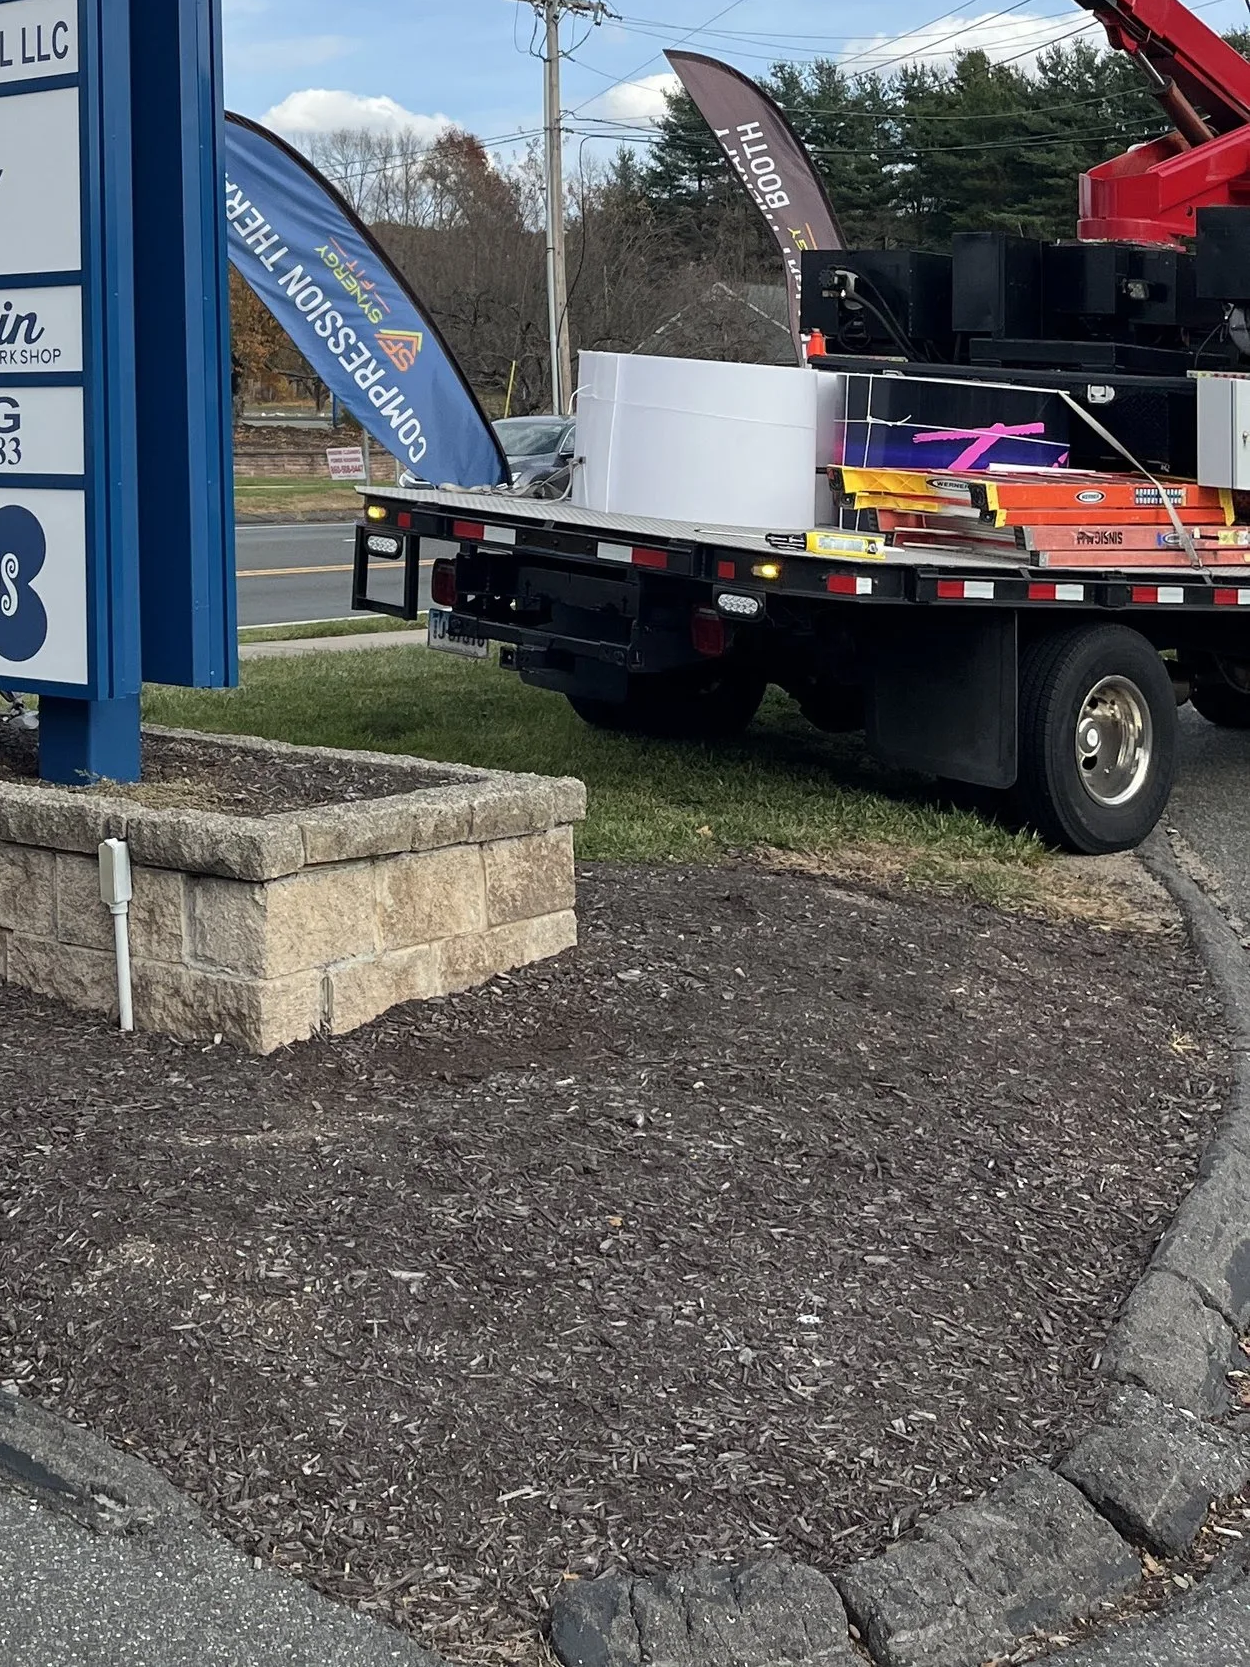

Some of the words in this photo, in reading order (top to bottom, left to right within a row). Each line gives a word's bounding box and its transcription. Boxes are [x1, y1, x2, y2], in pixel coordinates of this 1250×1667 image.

[20, 20, 69, 63] LLC
[736, 120, 791, 210] BOOTH
[313, 244, 384, 325] SYNERGY
[278, 264, 427, 464] COMPRESSION
